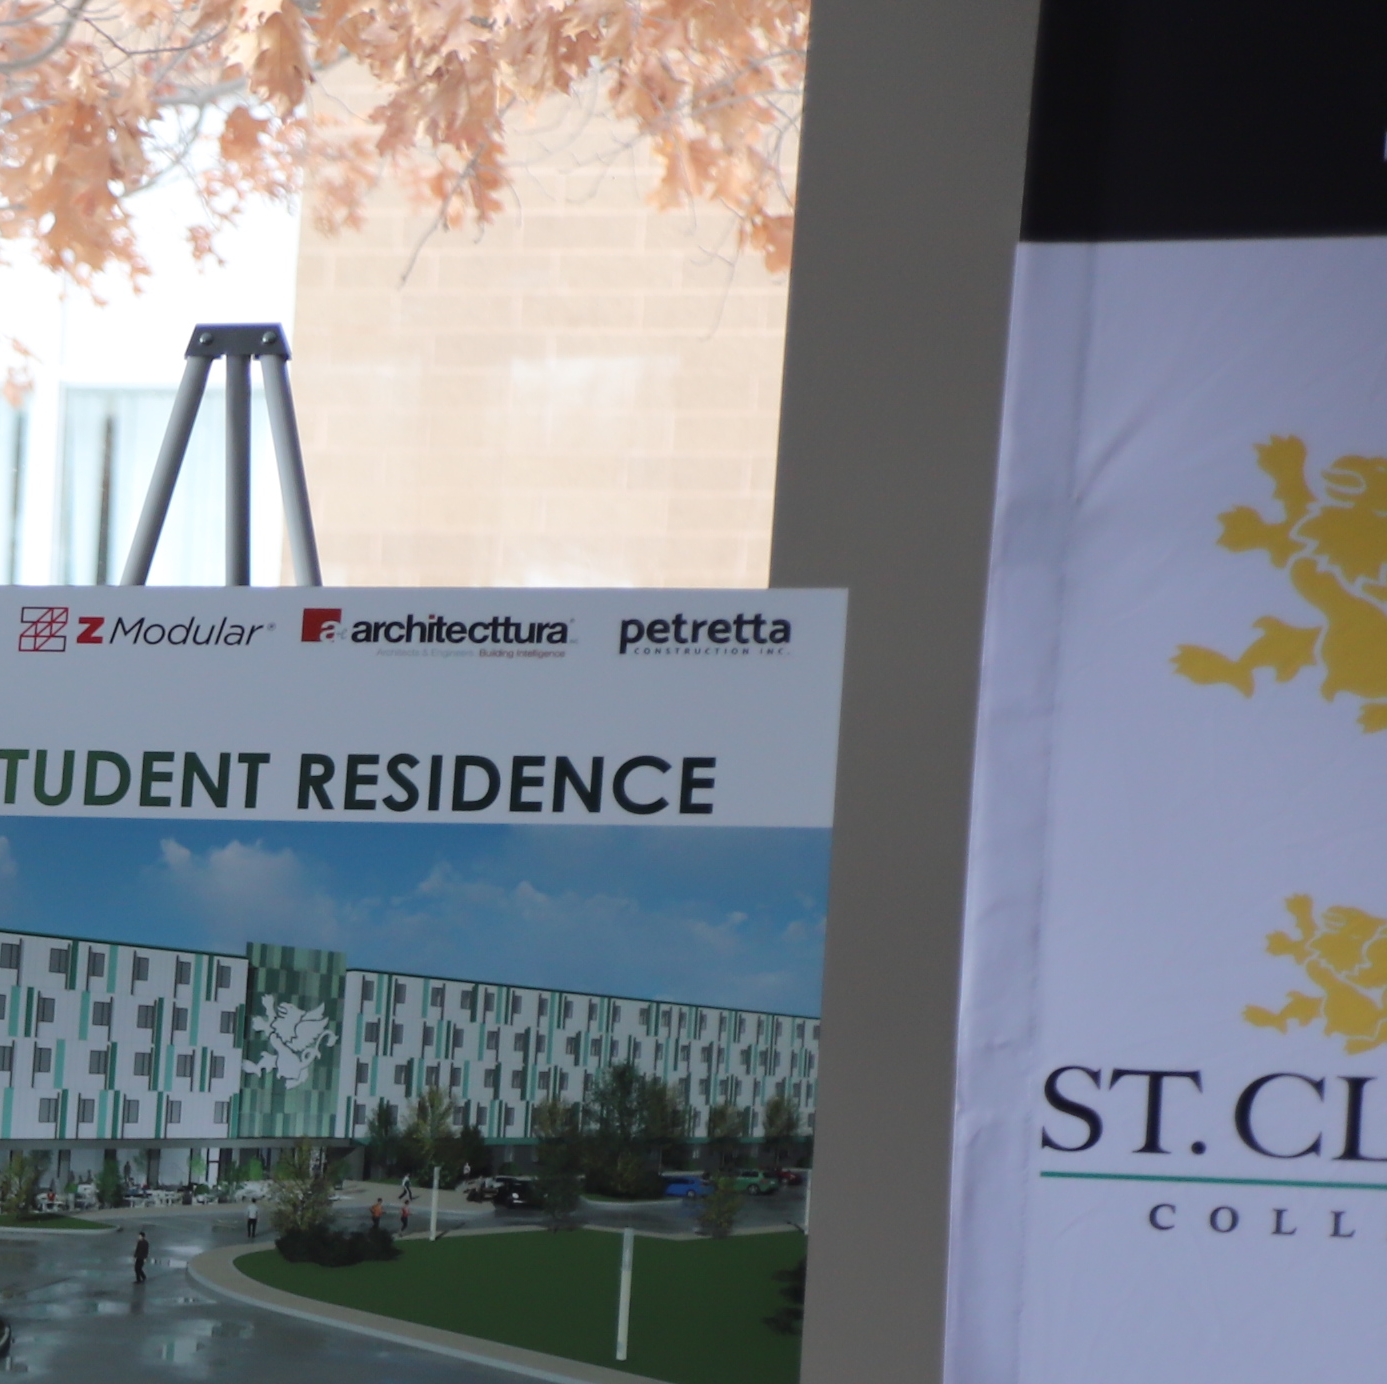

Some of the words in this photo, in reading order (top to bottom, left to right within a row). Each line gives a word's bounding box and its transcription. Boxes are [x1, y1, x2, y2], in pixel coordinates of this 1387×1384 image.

[109, 615, 263, 646] Modular
[351, 615, 569, 645] architecttura
[619, 613, 792, 654] petretta
[479, 649, 514, 659] Building
[634, 647, 749, 655] CONSTRUCTION
[295, 752, 717, 816] RESIDENCE
[1149, 1203, 1387, 1239] COLL
